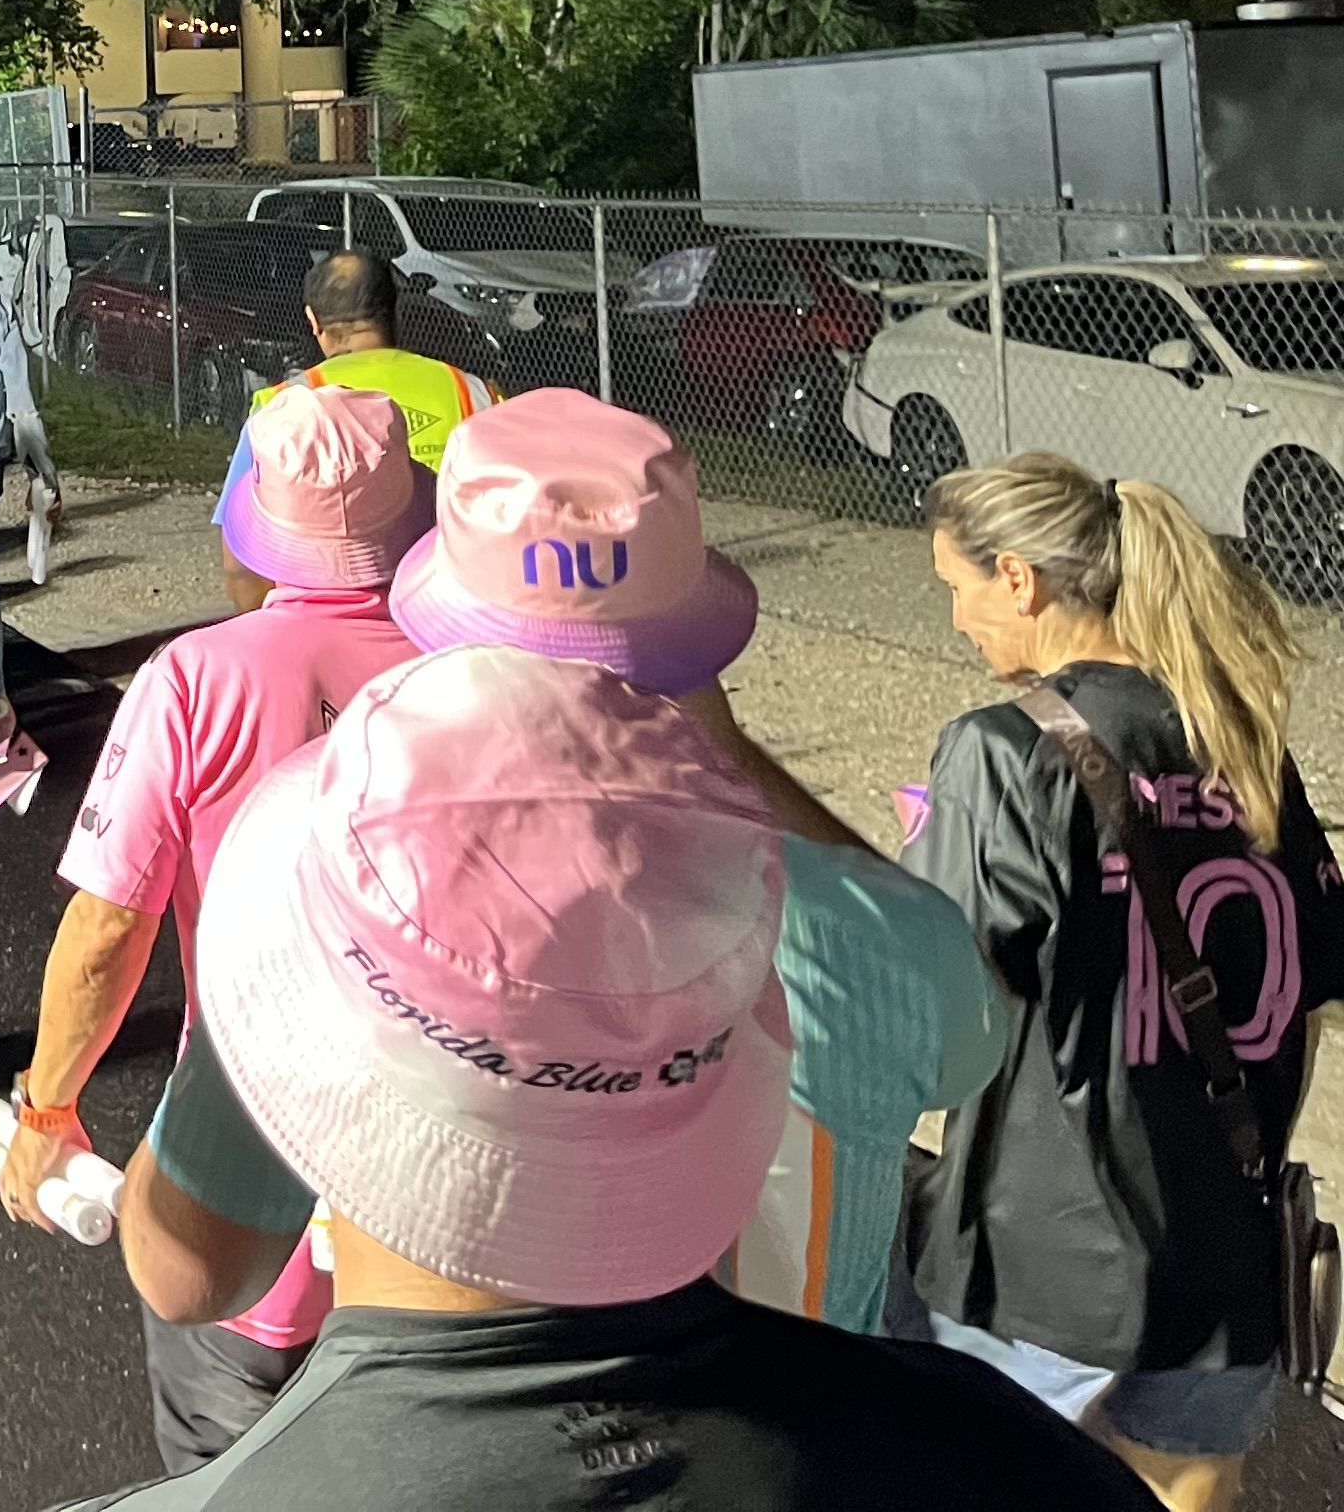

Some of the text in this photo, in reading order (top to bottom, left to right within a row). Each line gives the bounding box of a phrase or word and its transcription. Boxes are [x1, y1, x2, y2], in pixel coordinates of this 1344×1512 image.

[522, 538, 628, 589] nu
[344, 937, 643, 1094] Florida Blue
[1101, 852, 1302, 1065] 10
